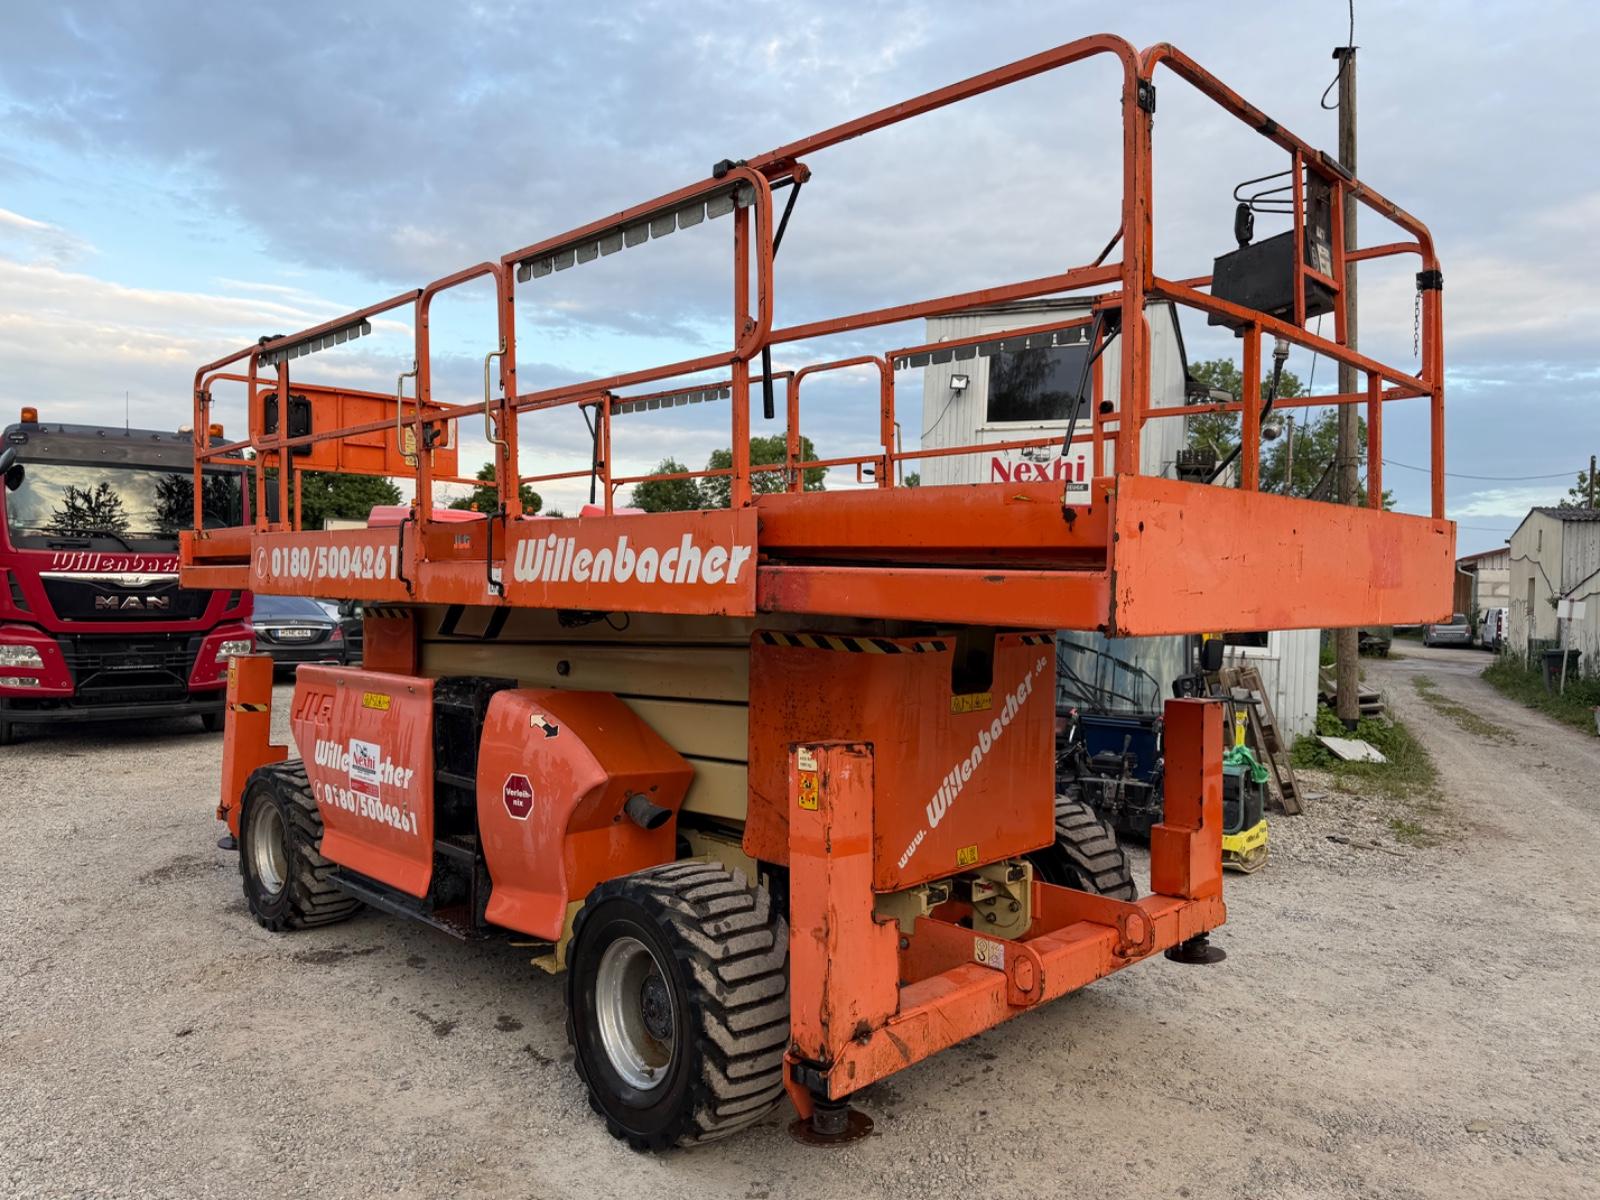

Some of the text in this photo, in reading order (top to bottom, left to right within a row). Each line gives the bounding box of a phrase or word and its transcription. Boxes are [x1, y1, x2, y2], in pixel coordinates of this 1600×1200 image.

[991, 455, 1085, 482] Nexhi
[271, 545, 398, 581] 0180/5004261
[513, 533, 751, 584] Willenbacher
[95, 596, 169, 609] MAN
[505, 788, 531, 798] Verleih-
[324, 783, 418, 836] 0180/5004261
